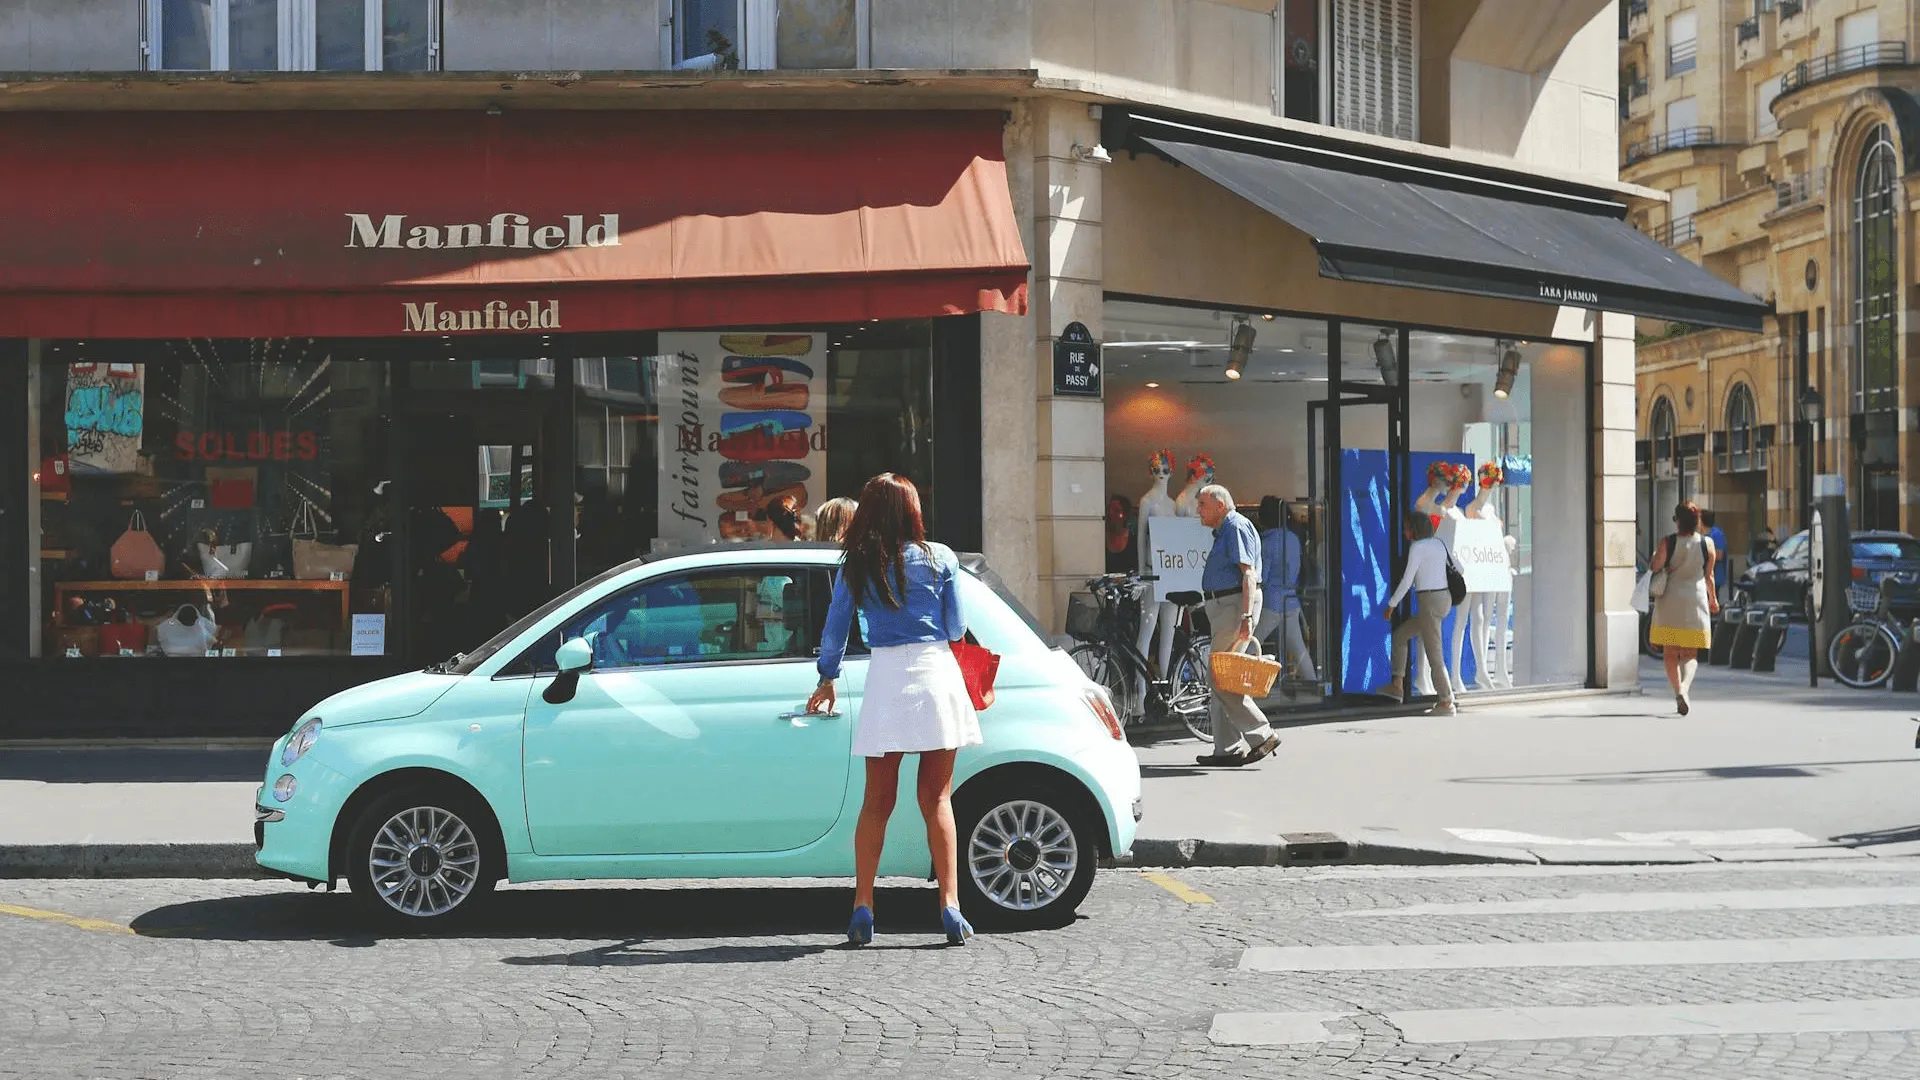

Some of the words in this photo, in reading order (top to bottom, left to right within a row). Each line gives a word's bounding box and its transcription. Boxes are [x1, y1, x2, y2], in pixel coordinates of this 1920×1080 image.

[344, 213, 622, 249] Manfield
[1538, 281, 1561, 298] TARA
[1563, 284, 1598, 303] JARMON
[402, 300, 561, 332] Manfield
[1069, 352, 1085, 364] RUE
[1065, 375, 1089, 386] PASSY
[172, 430, 319, 461] SOLDES
[675, 424, 827, 452] Manfield
[1157, 549, 1184, 568] Tara
[1473, 546, 1503, 563] Soldes
